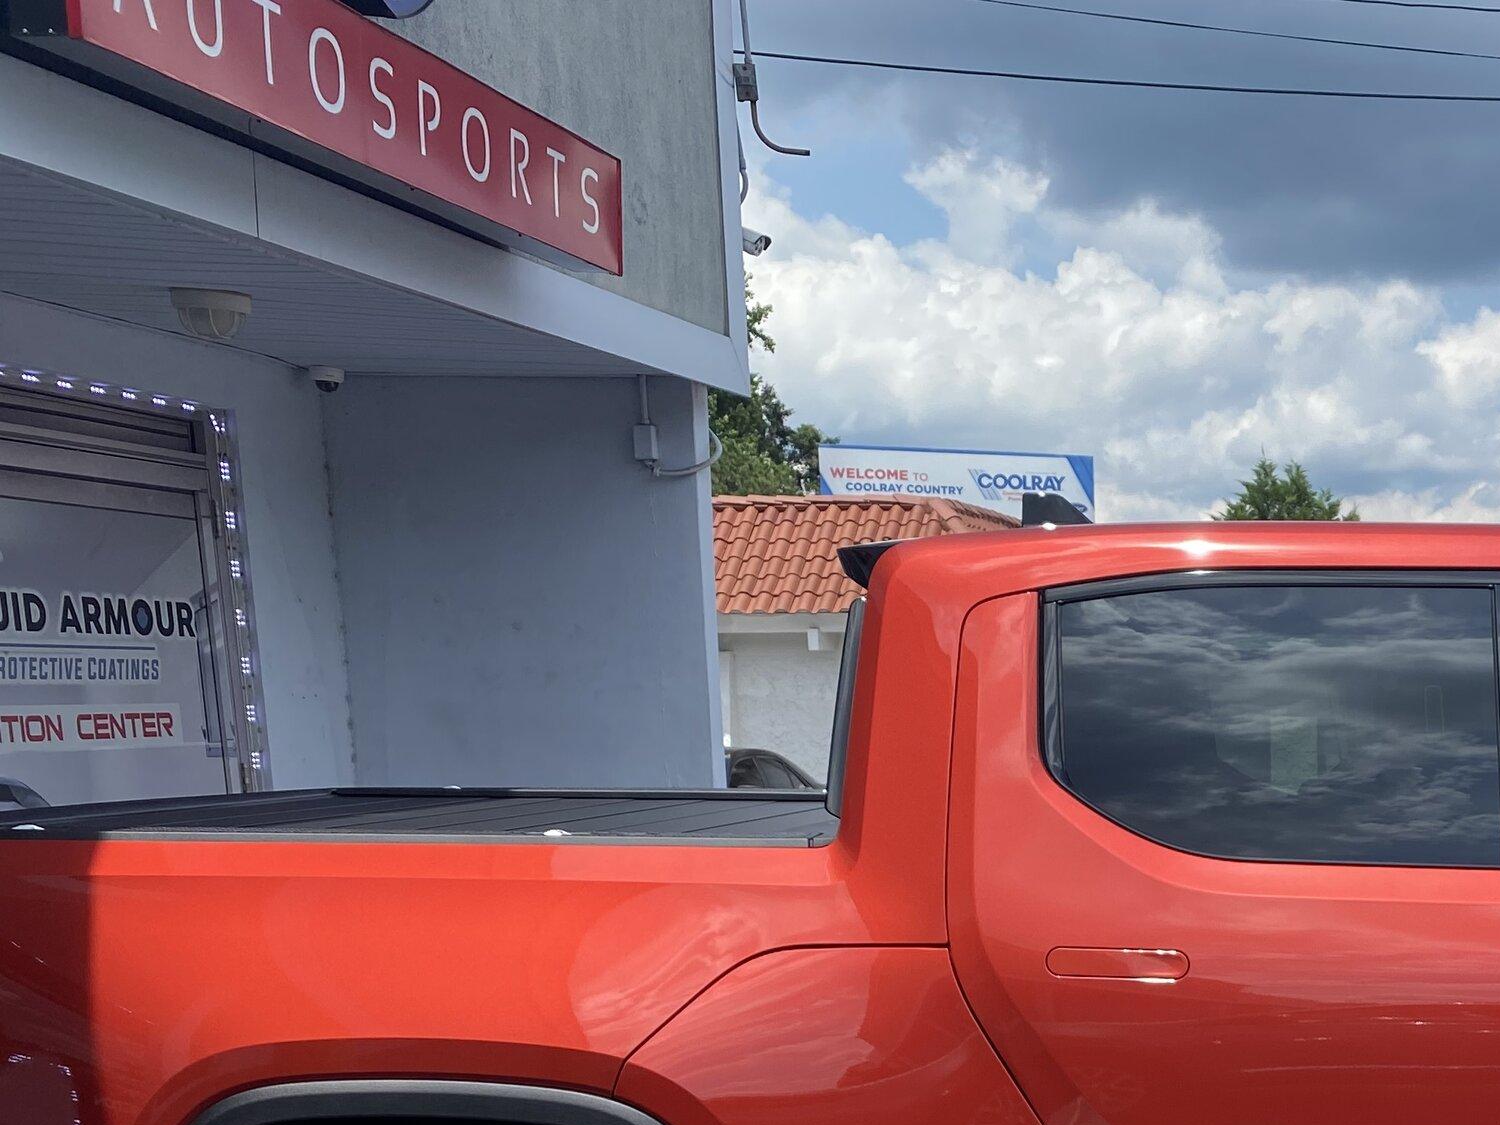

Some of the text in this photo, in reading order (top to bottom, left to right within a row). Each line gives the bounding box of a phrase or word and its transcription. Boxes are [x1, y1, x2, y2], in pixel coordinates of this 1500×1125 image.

[830, 467, 929, 482] WELCOME TO
[977, 472, 1066, 492] COOLRAY
[845, 482, 964, 495] COOLRAY COUNTRY
[60, 595, 196, 637] ARMOUR
[87, 657, 159, 680] COATINGS
[0, 712, 174, 743] TION CENTER
